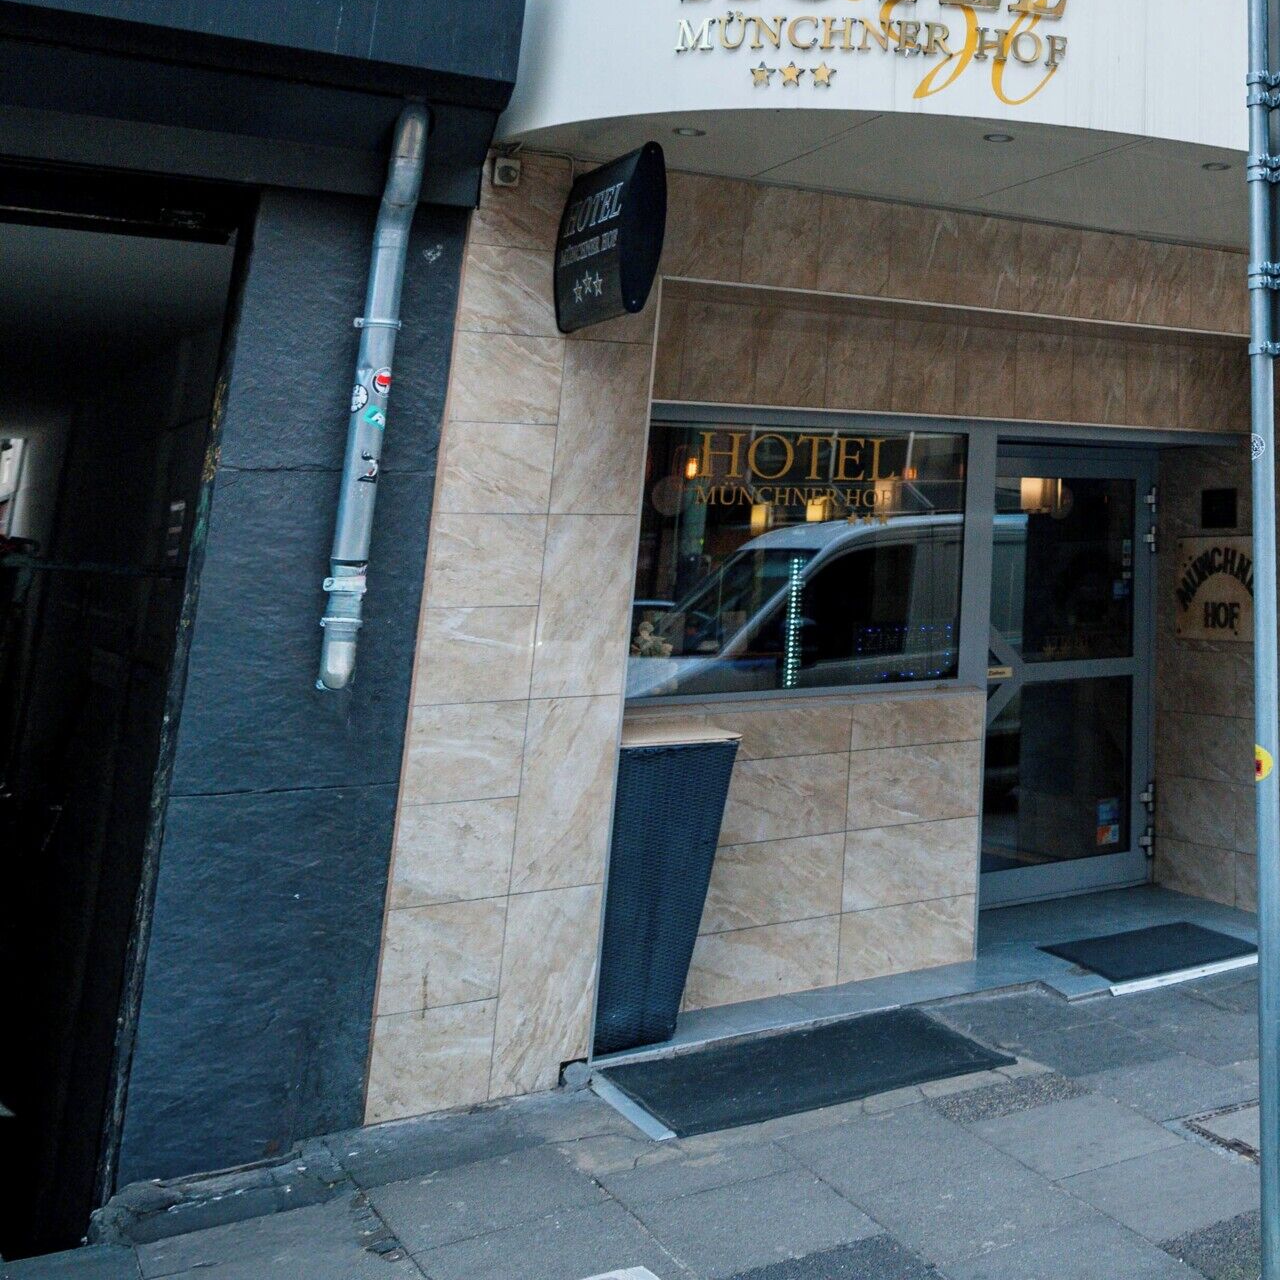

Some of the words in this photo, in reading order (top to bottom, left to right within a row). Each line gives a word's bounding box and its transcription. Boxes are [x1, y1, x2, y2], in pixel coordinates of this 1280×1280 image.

[675, 10, 952, 57] MÜNCHNER
[975, 26, 1067, 69] HOF
[563, 182, 624, 238] HOTEL
[697, 432, 900, 481] HOTEL
[695, 482, 837, 507] MÜNCHNER
[843, 489, 894, 507] HOF
[1176, 547, 1254, 612] MÜNCHN
[1204, 602, 1240, 629] HOF
